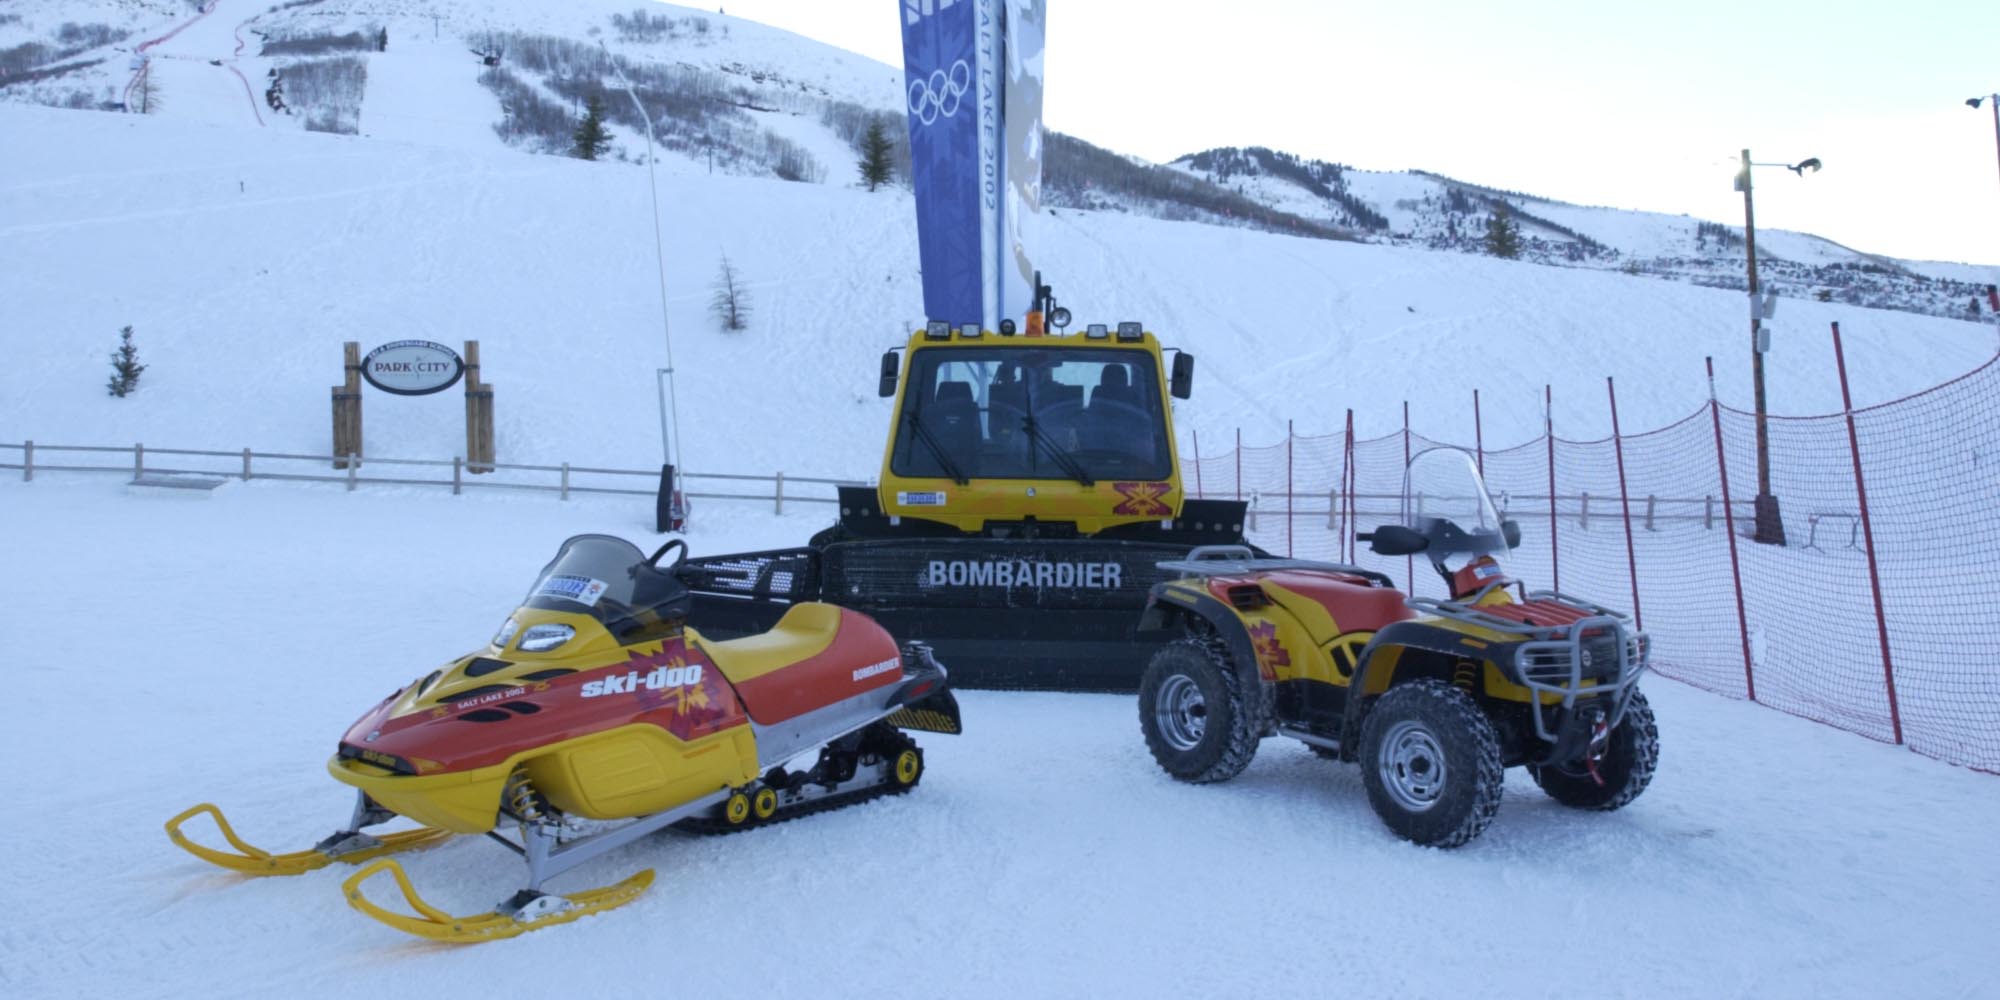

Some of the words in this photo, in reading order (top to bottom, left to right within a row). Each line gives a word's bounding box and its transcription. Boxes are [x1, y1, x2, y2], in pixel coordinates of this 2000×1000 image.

[980, 0, 992, 58] SALT
[982, 68, 994, 137] LAKE
[984, 148, 995, 211] 2002
[375, 362, 412, 372] PARK
[418, 362, 450, 372] CITY
[928, 560, 1122, 588] BOMBARDIER
[580, 664, 703, 698] ski-doo
[852, 656, 900, 682] BOMBARDIER
[457, 699, 478, 710] SALT
[480, 692, 504, 705] LAKE
[505, 686, 526, 698] 2002
